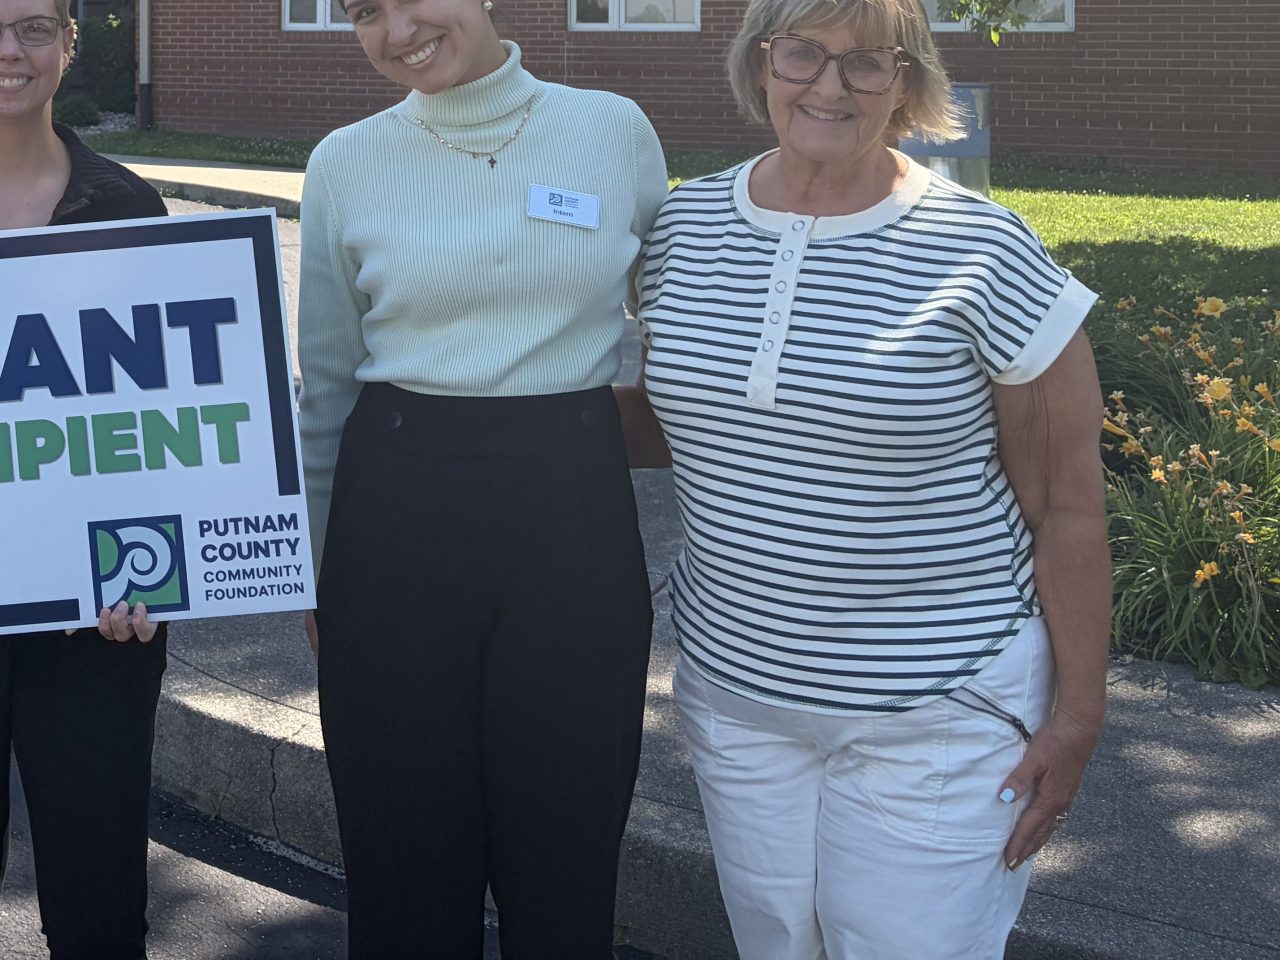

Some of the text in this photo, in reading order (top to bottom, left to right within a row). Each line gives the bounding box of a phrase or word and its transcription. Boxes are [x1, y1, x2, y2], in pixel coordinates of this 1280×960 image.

[553, 208, 574, 218] Intern
[198, 513, 299, 538] PUTNAM
[200, 537, 300, 563] COUNTY
[203, 564, 303, 583] COMMUNITY
[205, 582, 305, 601] FOUNDATION
